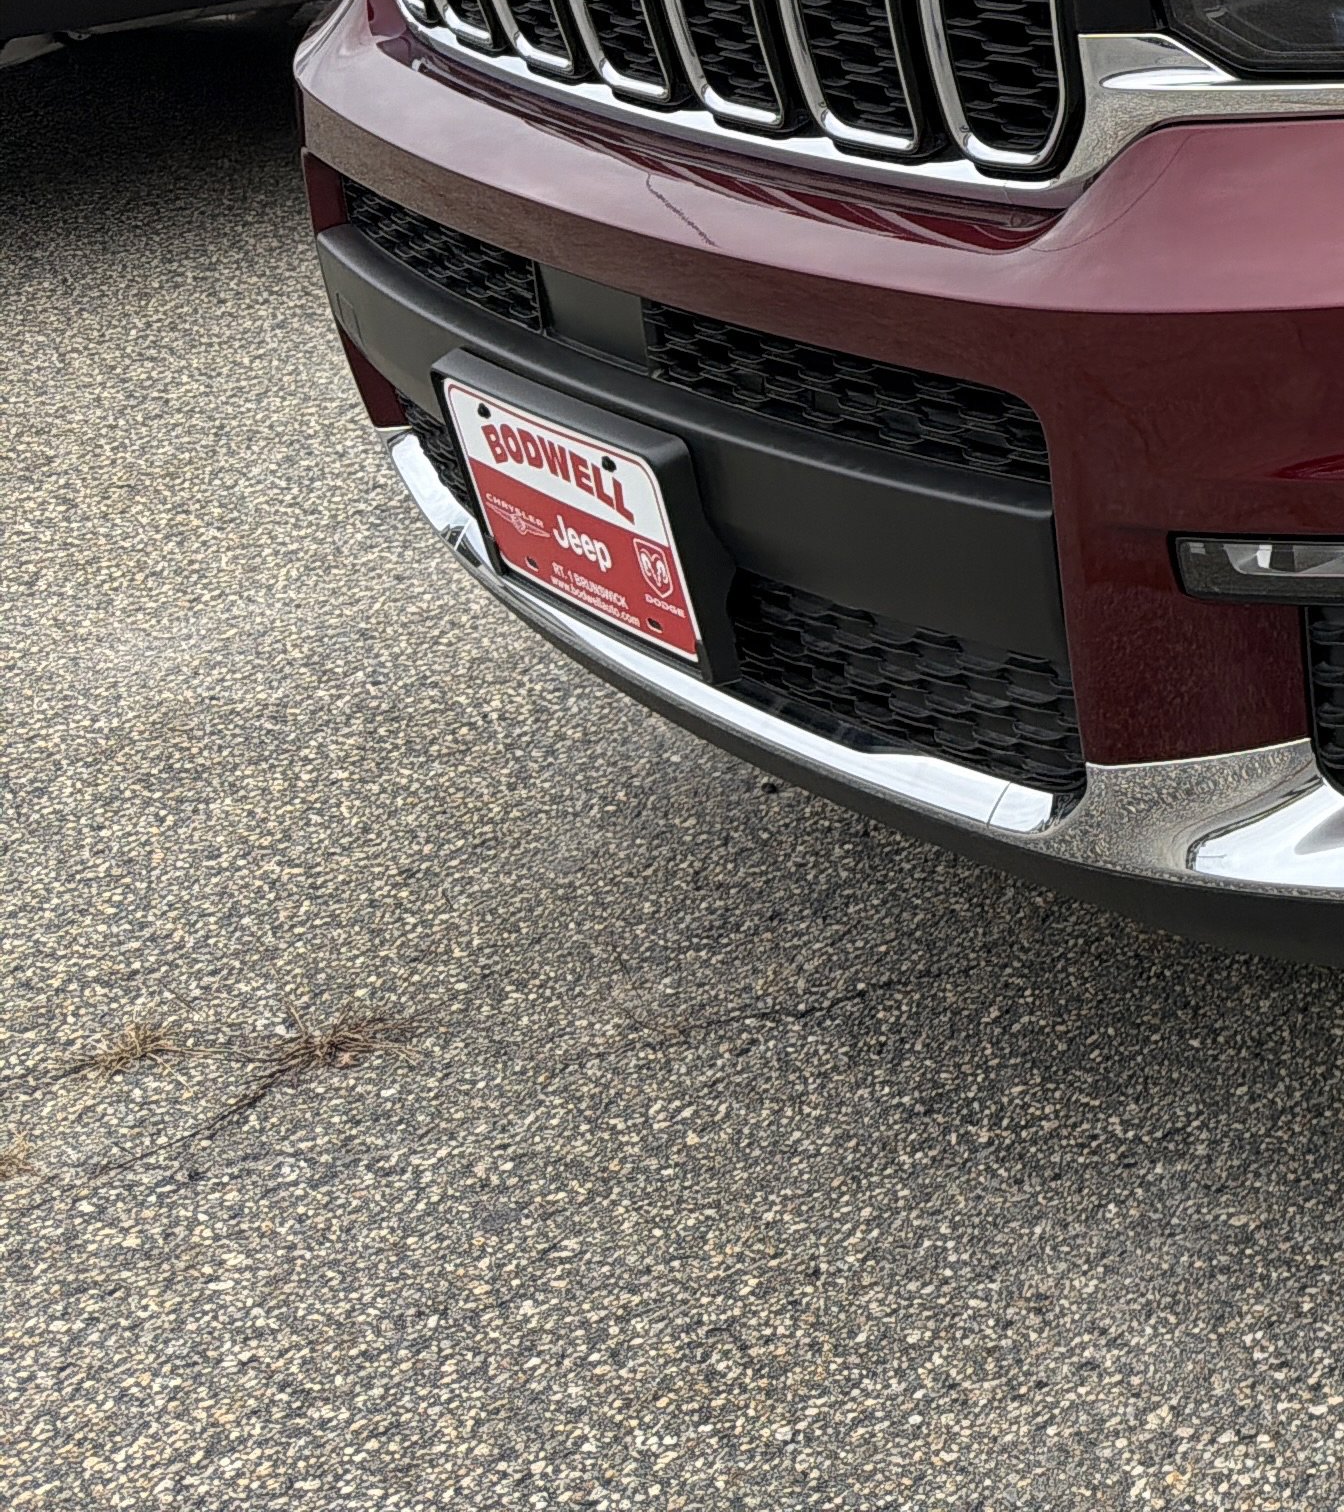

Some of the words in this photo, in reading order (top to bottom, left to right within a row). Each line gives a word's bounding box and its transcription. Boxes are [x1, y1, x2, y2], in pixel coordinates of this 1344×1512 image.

[481, 423, 636, 526] BODWELL
[485, 492, 545, 529] CHRYSLER
[552, 514, 613, 573] Jeep
[573, 572, 629, 610] BRUNSWICK
[644, 592, 687, 619] DODGE
